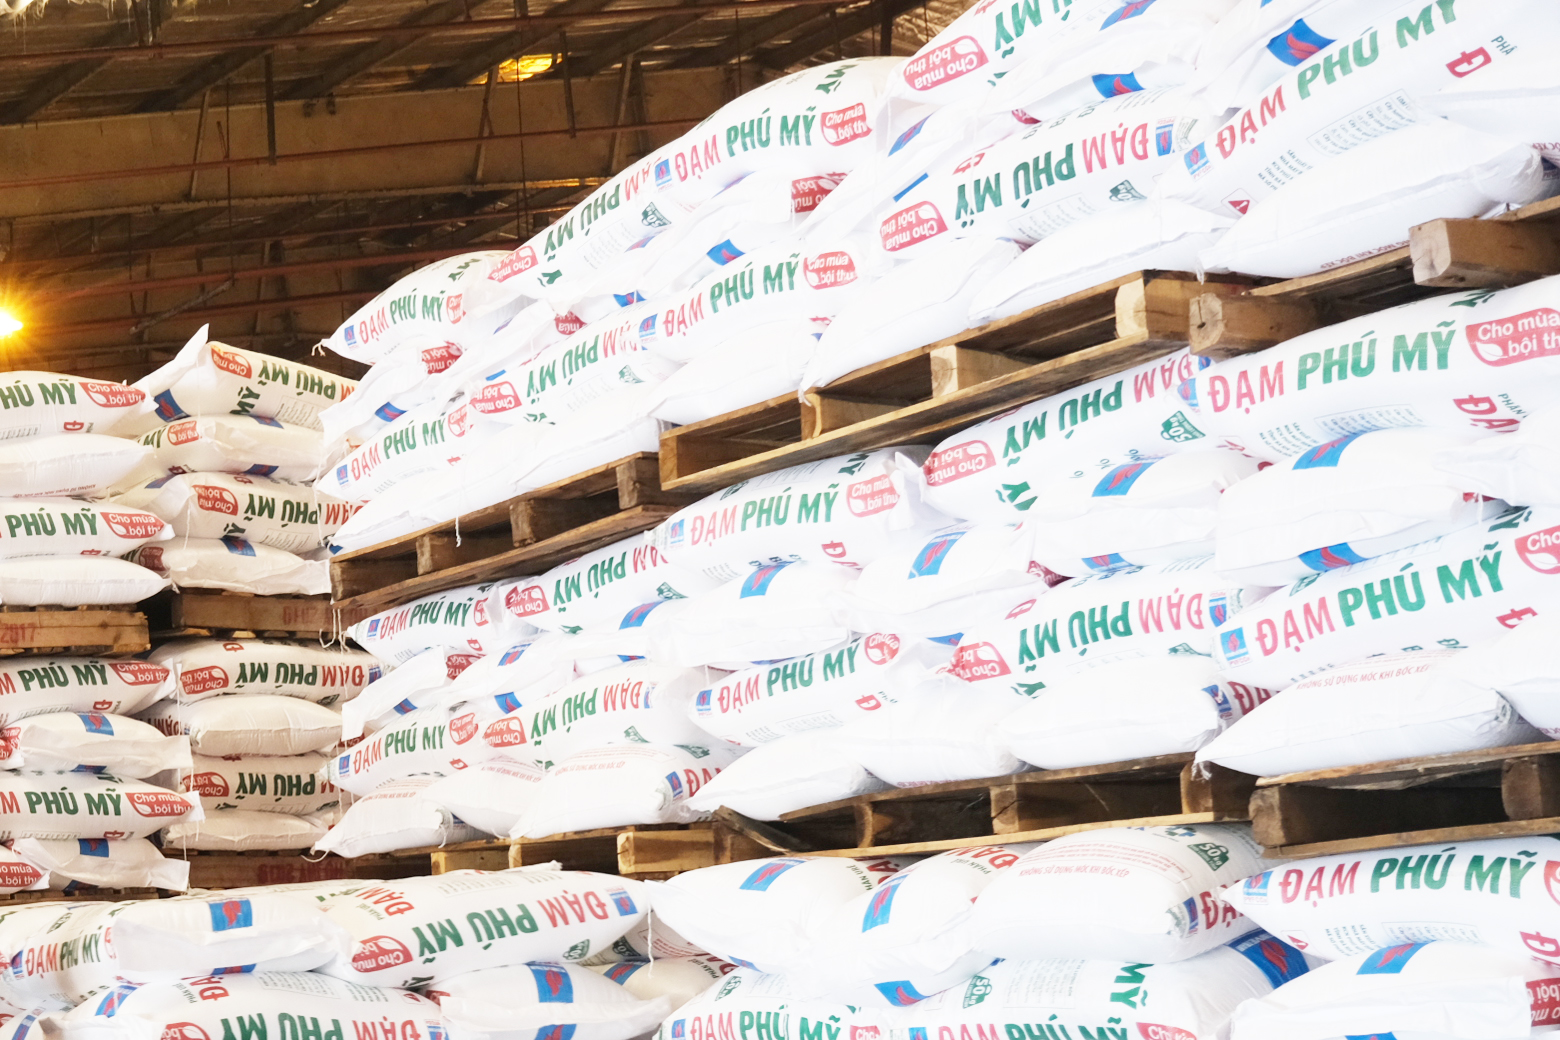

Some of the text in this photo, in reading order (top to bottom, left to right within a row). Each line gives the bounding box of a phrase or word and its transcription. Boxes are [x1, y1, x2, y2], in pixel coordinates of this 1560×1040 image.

[905, 60, 927, 76] thu
[947, 54, 978, 74] Cho
[663, 254, 799, 337] ĐẠM PHÚ MỸ
[1478, 311, 1560, 341] Cho mùa
[1208, 320, 1456, 414] ĐẠM PHÚ MỸ
[1507, 334, 1537, 357] bội
[1003, 351, 1198, 467] ĐẠM PHÚ MỸ
[6, 508, 56, 537] PHÚ
[62, 509, 96, 535] MỸ
[691, 484, 839, 546] ĐẠM PHÚ MỸ
[1256, 542, 1504, 656] ĐẠM PHÚ MỸ
[26, 782, 77, 814] PHÚ
[86, 794, 120, 815] MỸ
[1279, 845, 1535, 906] ĐẠM PHÚ MỸ
[414, 890, 609, 963] ĐẠM PHÚ MỸ
